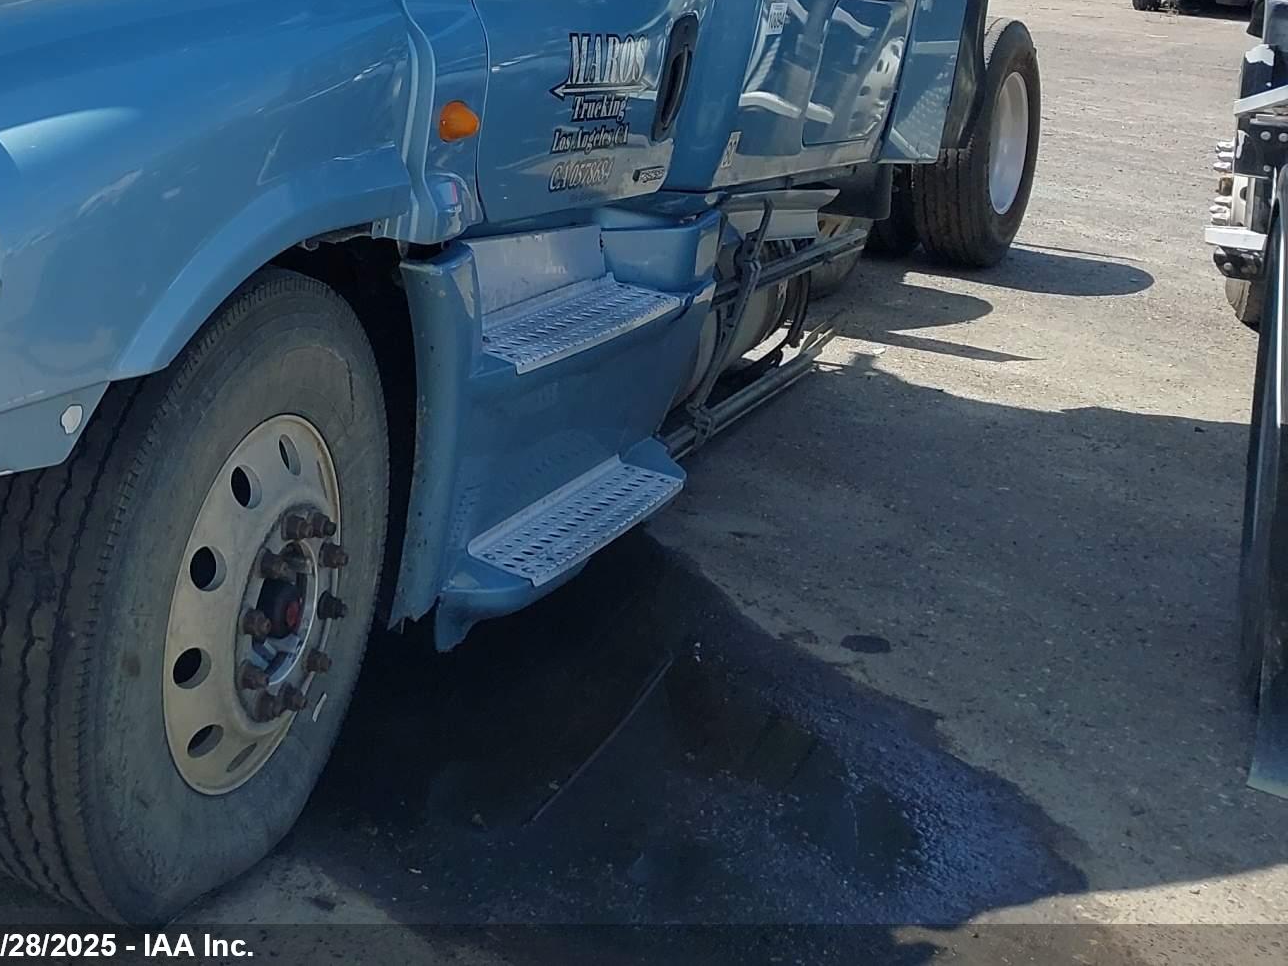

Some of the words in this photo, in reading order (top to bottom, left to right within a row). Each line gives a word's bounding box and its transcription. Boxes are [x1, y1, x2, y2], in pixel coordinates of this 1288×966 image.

[566, 32, 648, 85] MAROS
[570, 94, 629, 124] Trucking
[550, 128, 573, 154] Los
[572, 124, 612, 155] Angeles
